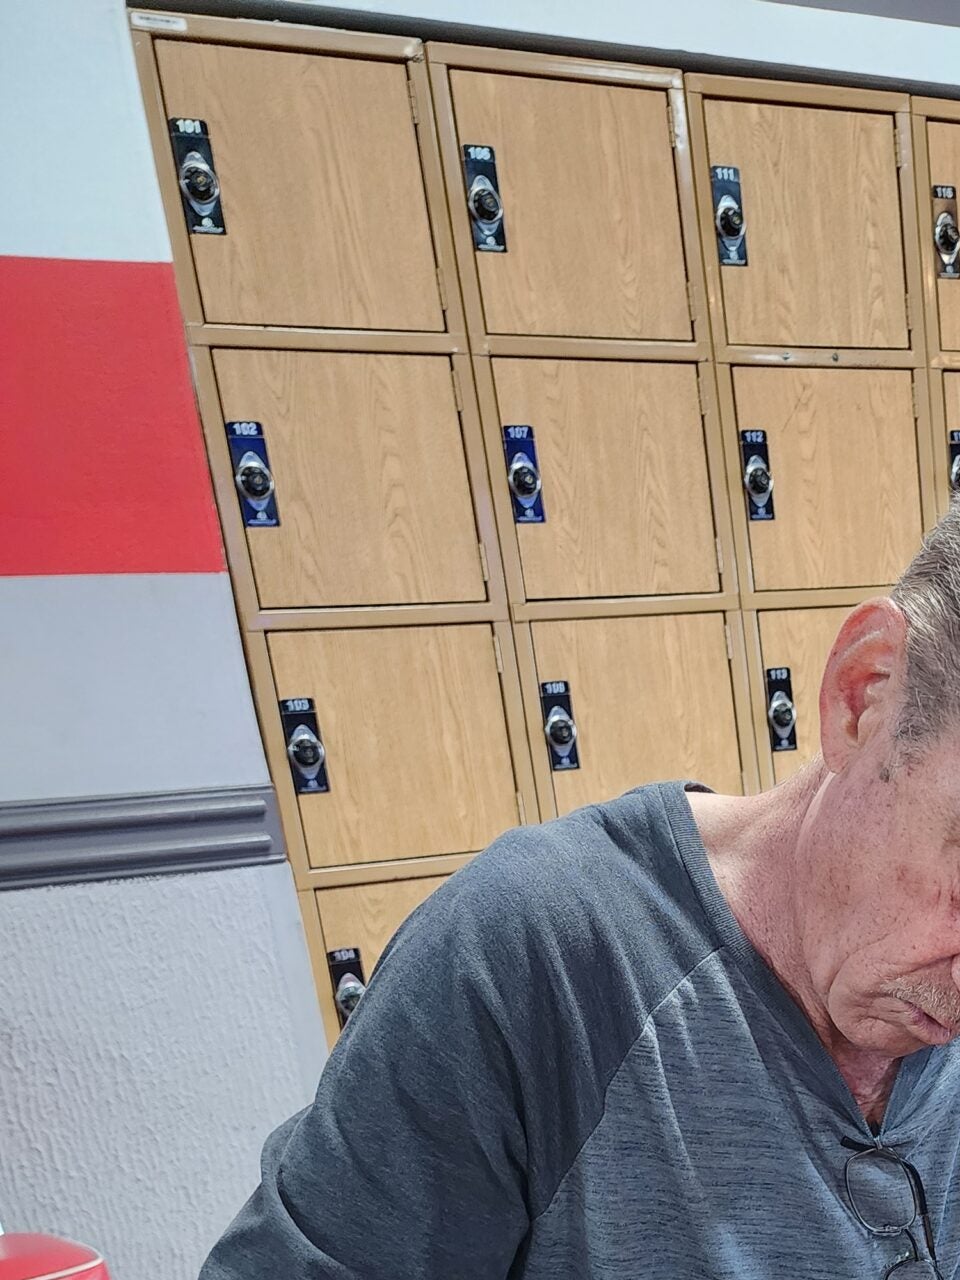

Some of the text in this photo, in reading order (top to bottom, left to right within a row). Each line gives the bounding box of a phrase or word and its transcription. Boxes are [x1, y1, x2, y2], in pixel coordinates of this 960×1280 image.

[176, 119, 202, 134] 101
[715, 167, 735, 181] 111
[233, 421, 258, 435] 102
[508, 426, 529, 439] 107
[745, 431, 763, 443] 112
